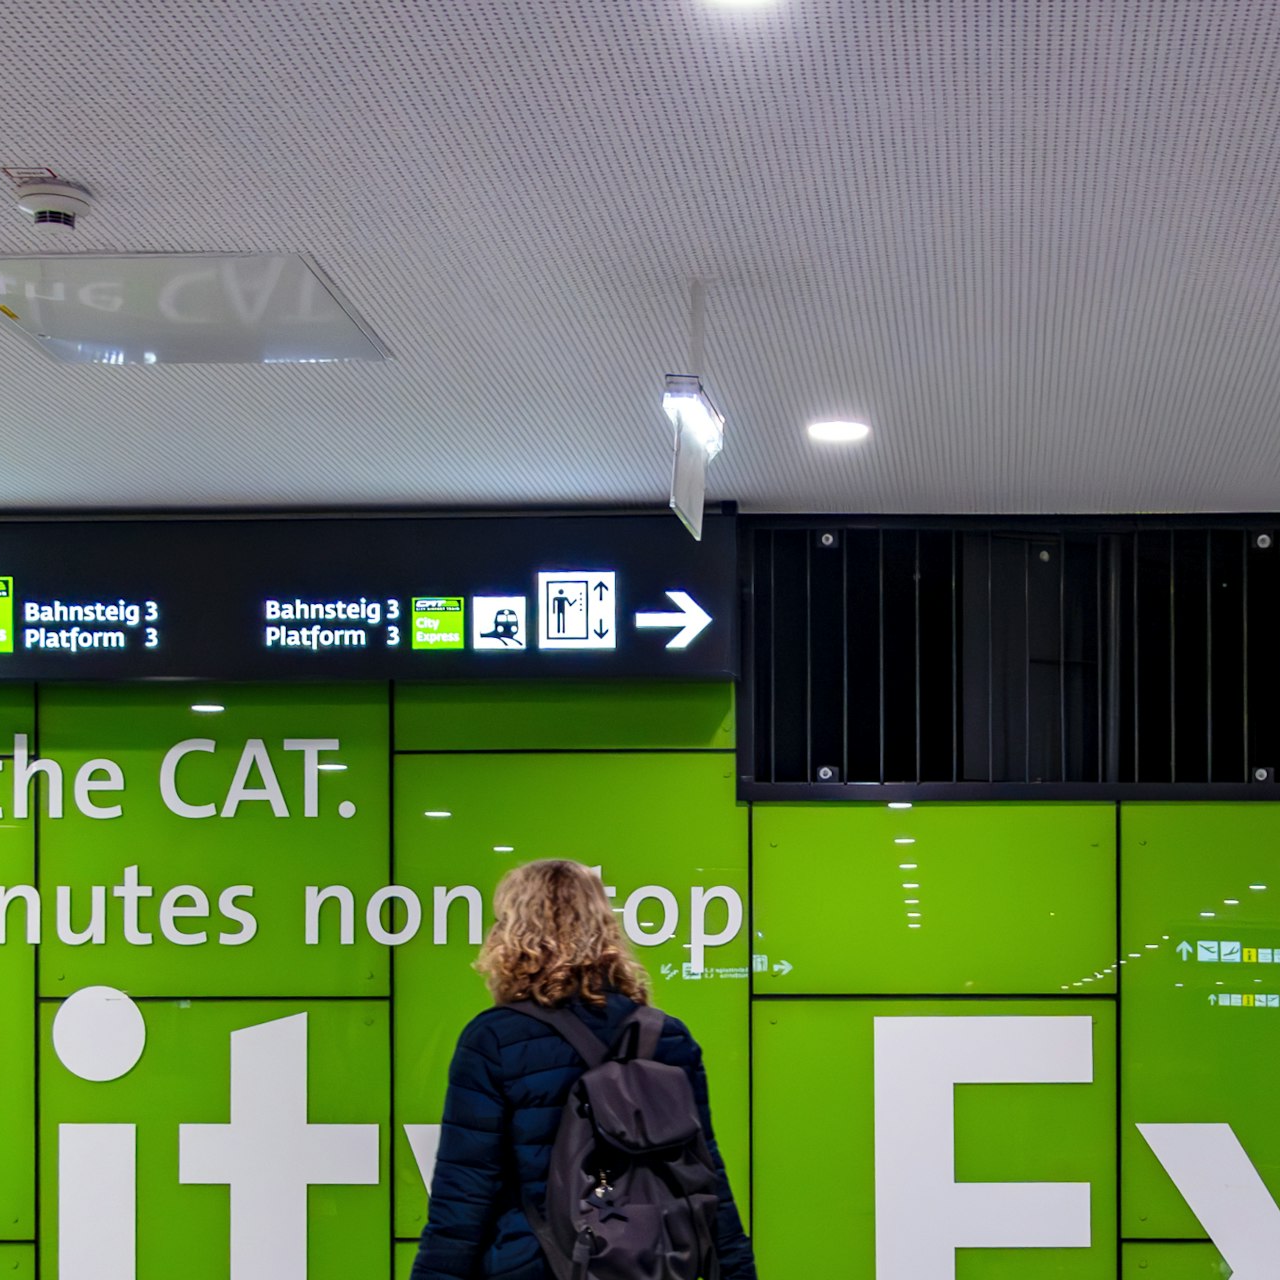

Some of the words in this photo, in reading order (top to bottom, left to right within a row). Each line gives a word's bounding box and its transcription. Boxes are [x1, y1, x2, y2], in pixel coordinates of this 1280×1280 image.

[24, 599, 140, 626] Bahnsteig
[145, 601, 159, 620] 3
[265, 598, 381, 625] Bahnsteig
[386, 599, 400, 619] 3
[415, 617, 440, 631] City
[24, 627, 125, 652] Platform
[145, 628, 159, 648] 3
[265, 625, 366, 650] Platform
[386, 626, 400, 646] 3
[415, 631, 461, 645] Express
[159, 738, 356, 819] CAT.
